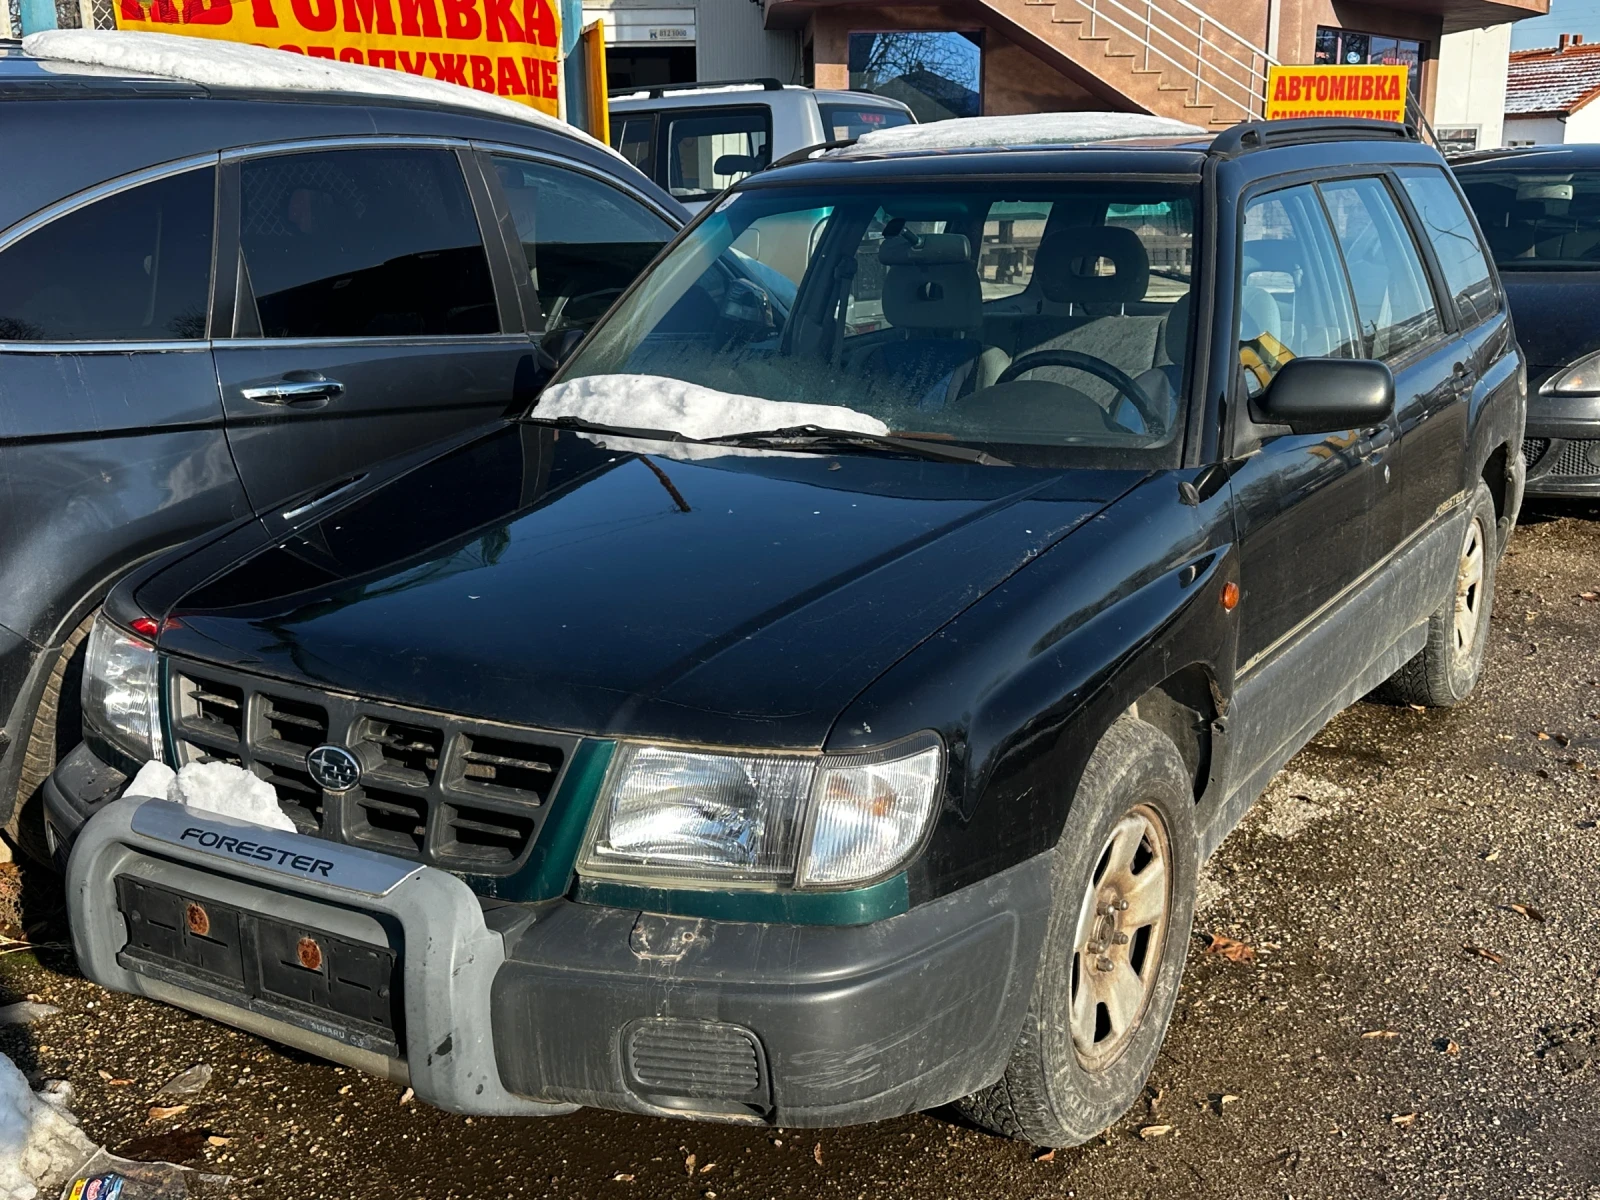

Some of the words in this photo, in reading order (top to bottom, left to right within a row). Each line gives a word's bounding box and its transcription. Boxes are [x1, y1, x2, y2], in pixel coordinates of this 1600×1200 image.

[1274, 75, 1401, 101] АВТОМИВКА
[180, 827, 335, 877] FORESTER
[311, 1022, 345, 1039] SUBARU
